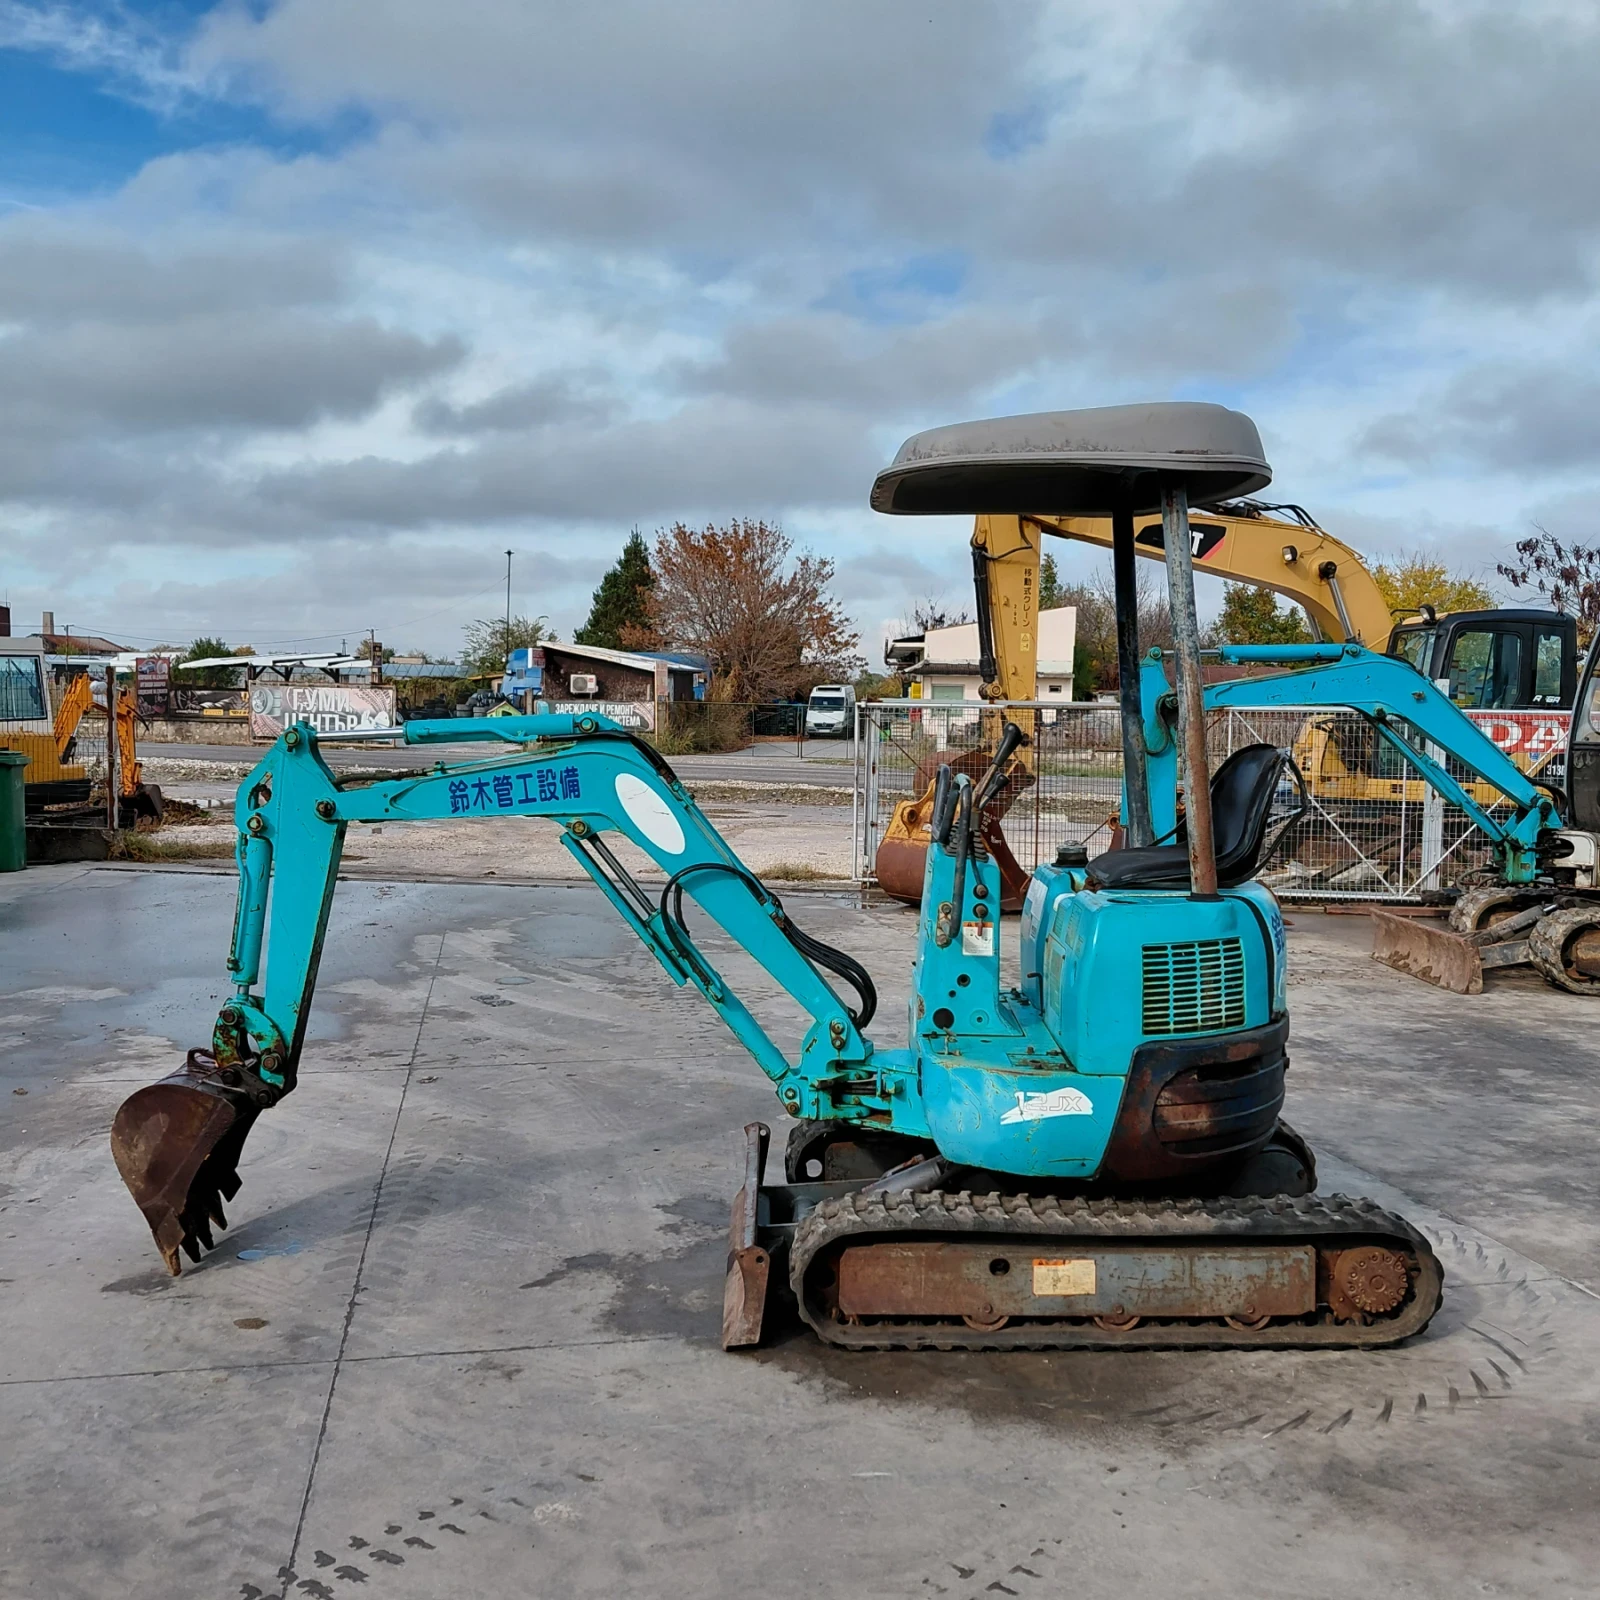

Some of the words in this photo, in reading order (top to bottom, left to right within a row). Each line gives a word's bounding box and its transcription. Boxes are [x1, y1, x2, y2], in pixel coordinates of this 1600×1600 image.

[1022, 568, 1032, 627] 移動式クレーン
[292, 689, 351, 712] ГУМИ
[606, 704, 634, 716] РЕМОНТ
[284, 712, 358, 732] ЦНТЪР
[448, 766, 581, 814] 鈴木管工設備
